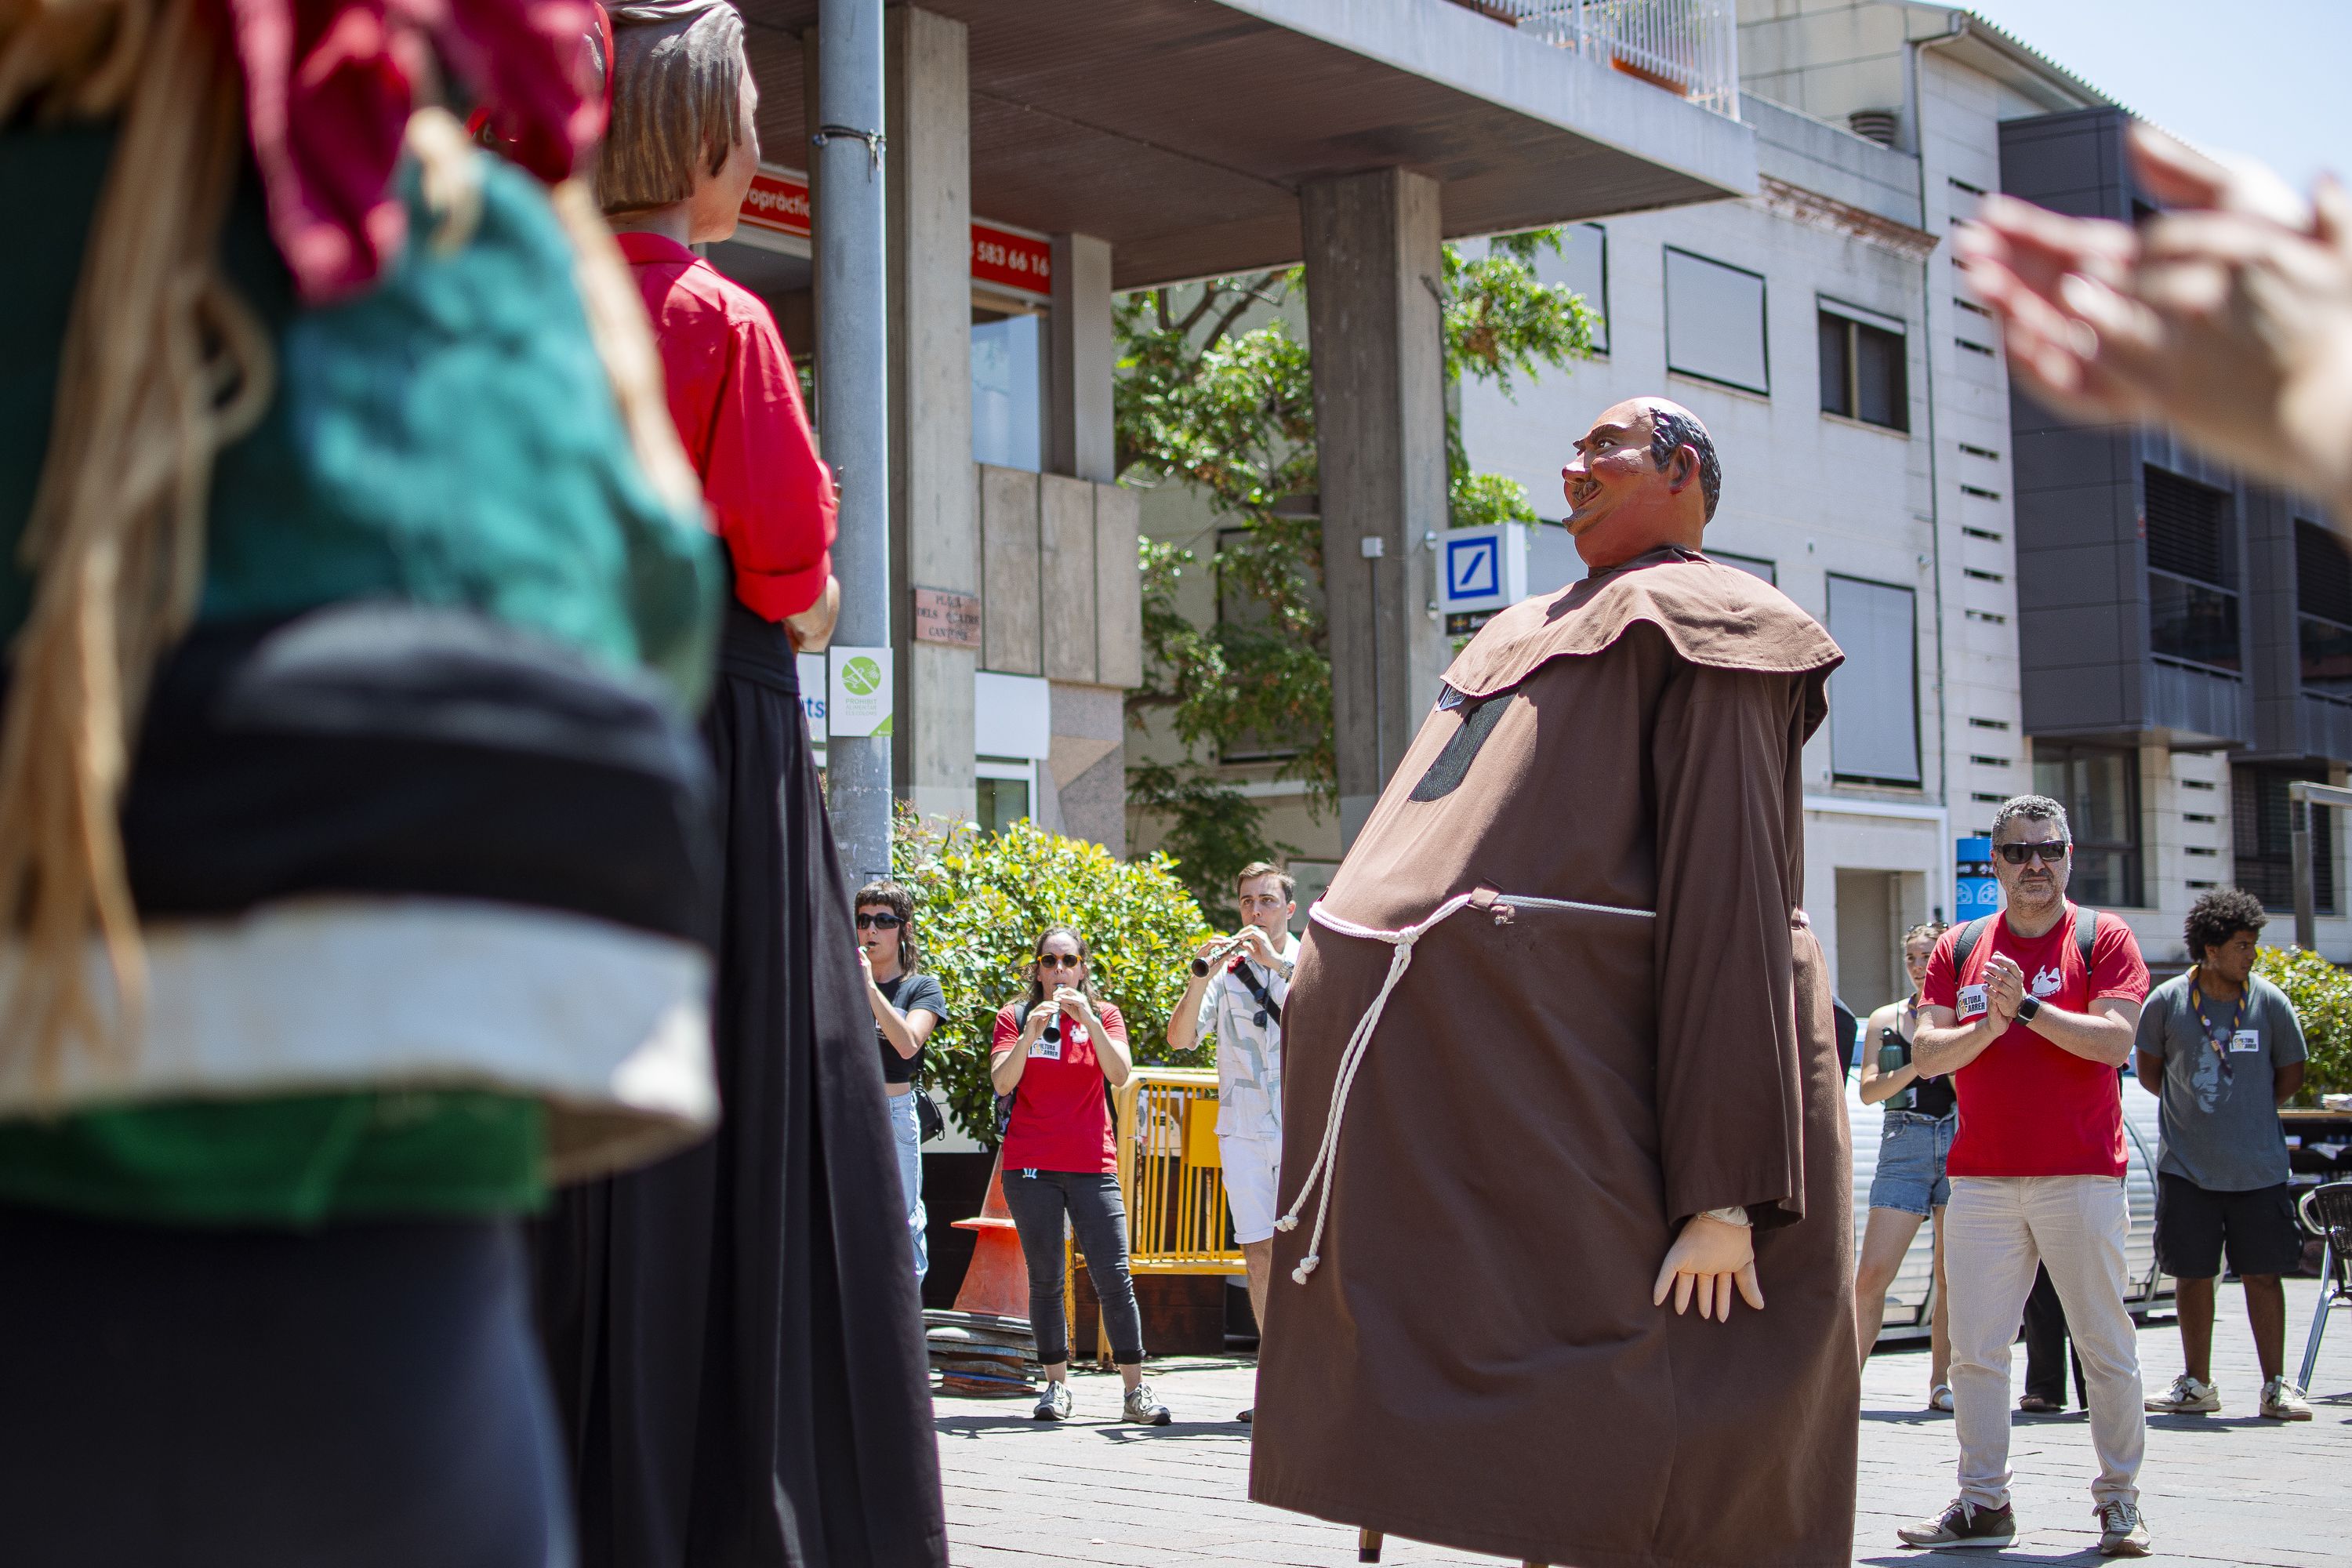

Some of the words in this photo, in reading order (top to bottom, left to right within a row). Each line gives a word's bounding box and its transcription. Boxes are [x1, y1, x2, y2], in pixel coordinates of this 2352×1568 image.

[977, 241, 1005, 266] 583
[1008, 249, 1028, 270] 66
[1031, 253, 1050, 277] 16
[801, 697, 825, 719] ts
